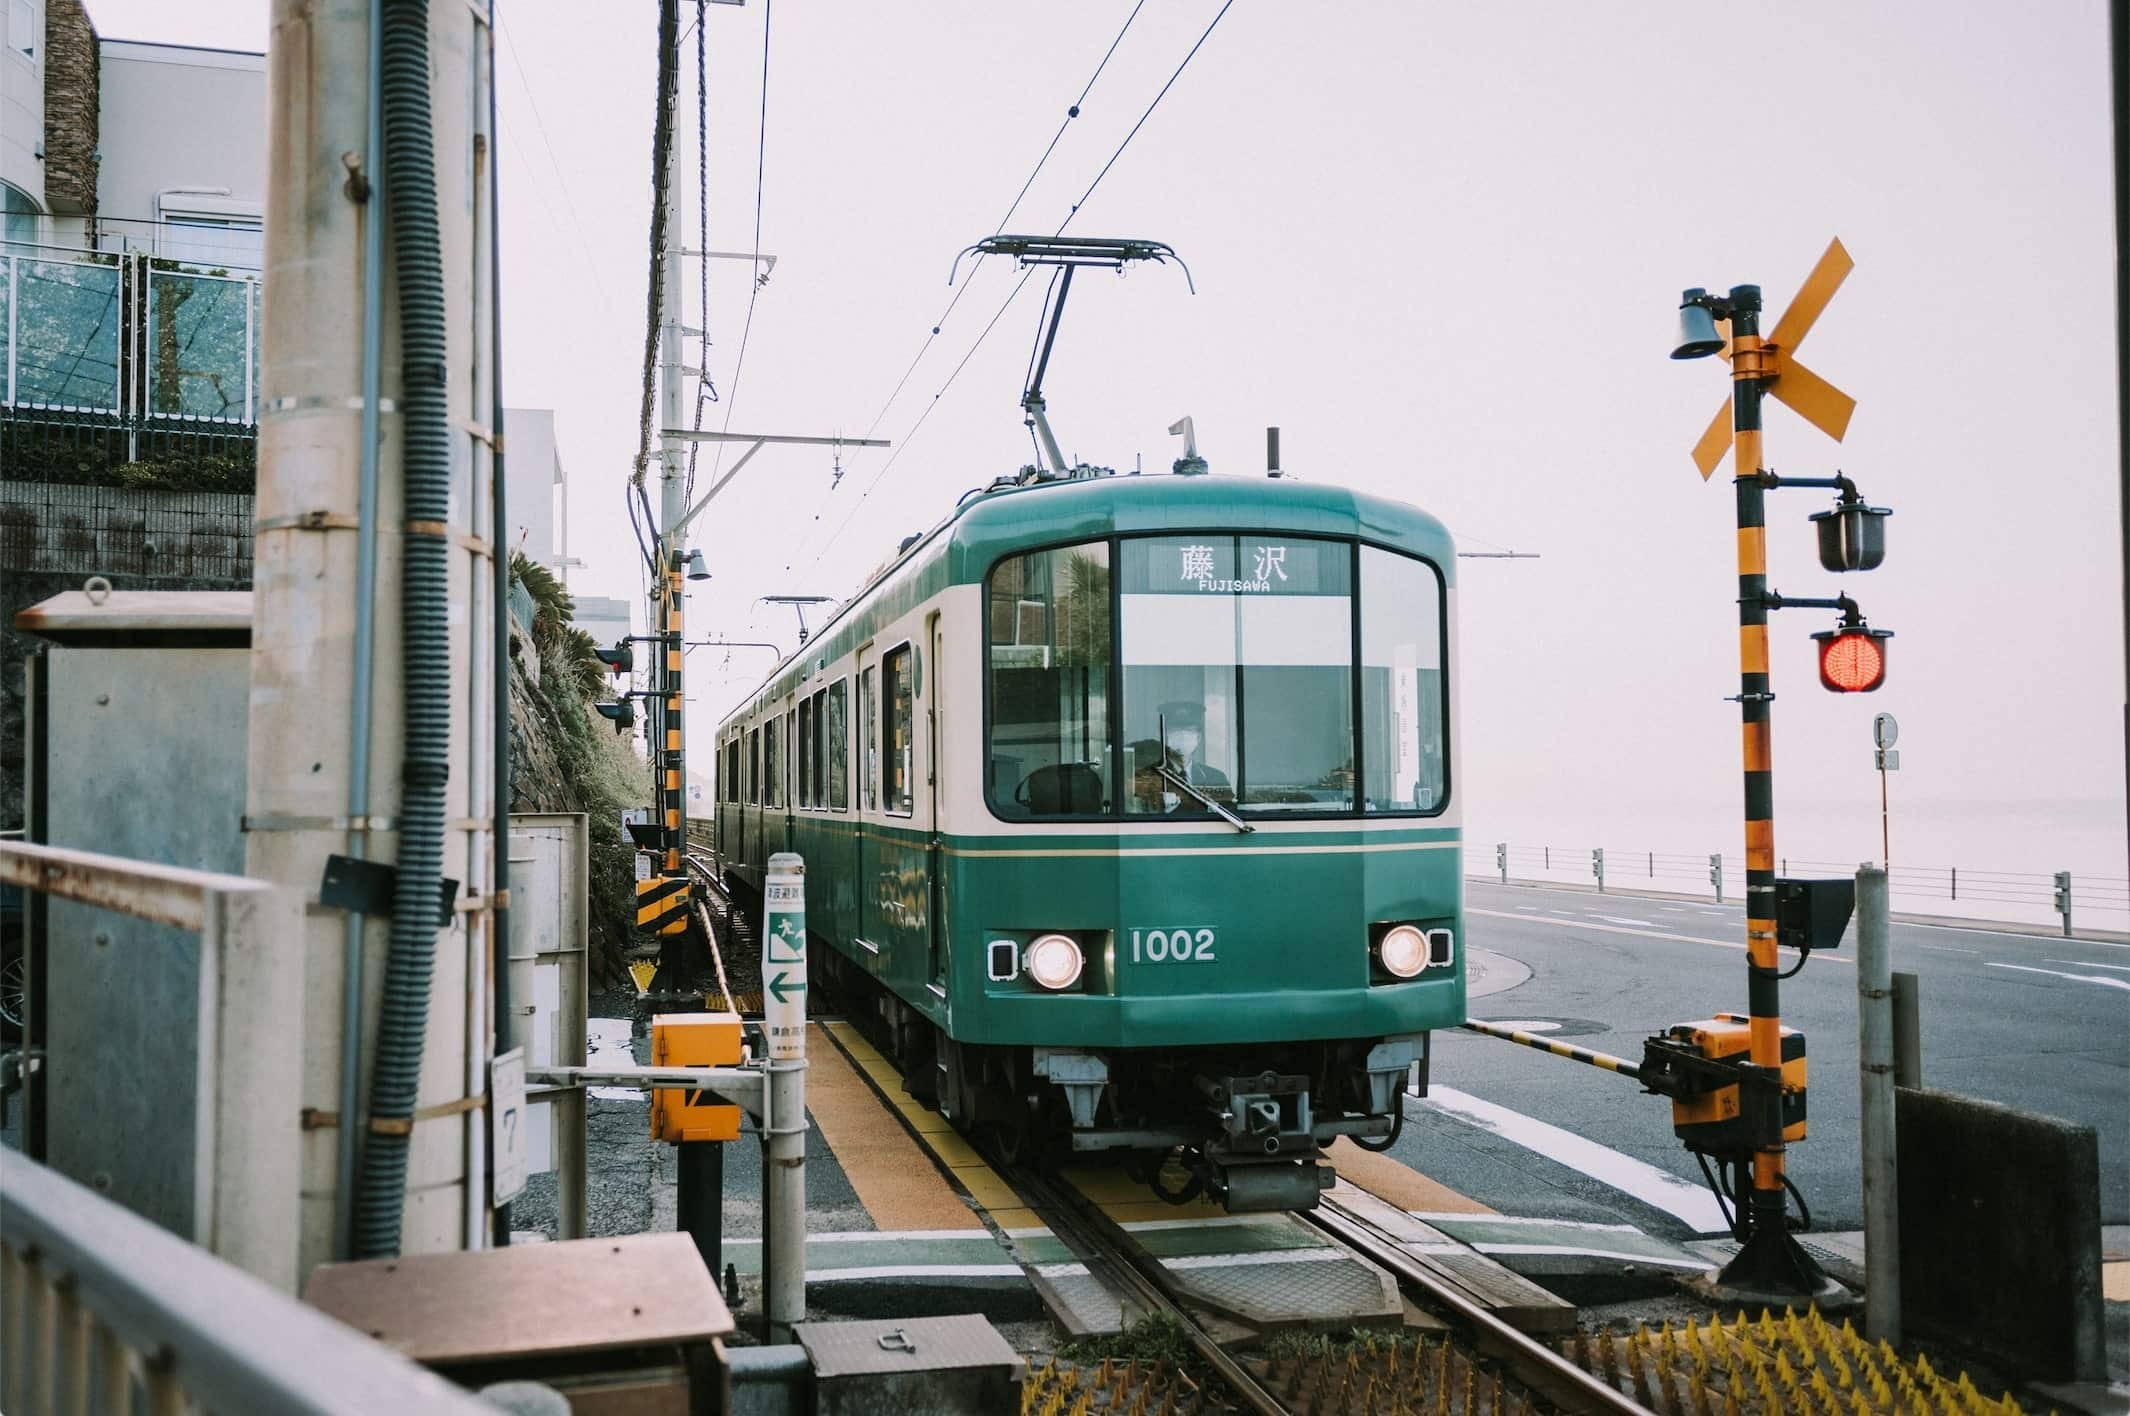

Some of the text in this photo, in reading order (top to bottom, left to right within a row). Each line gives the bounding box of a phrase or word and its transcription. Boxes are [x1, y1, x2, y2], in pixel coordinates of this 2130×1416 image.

[1180, 545, 1288, 581] 藤沢
[1199, 580, 1271, 592] FUJISAWA
[1132, 929, 1215, 962] 1002
[504, 1108, 517, 1153] 7
